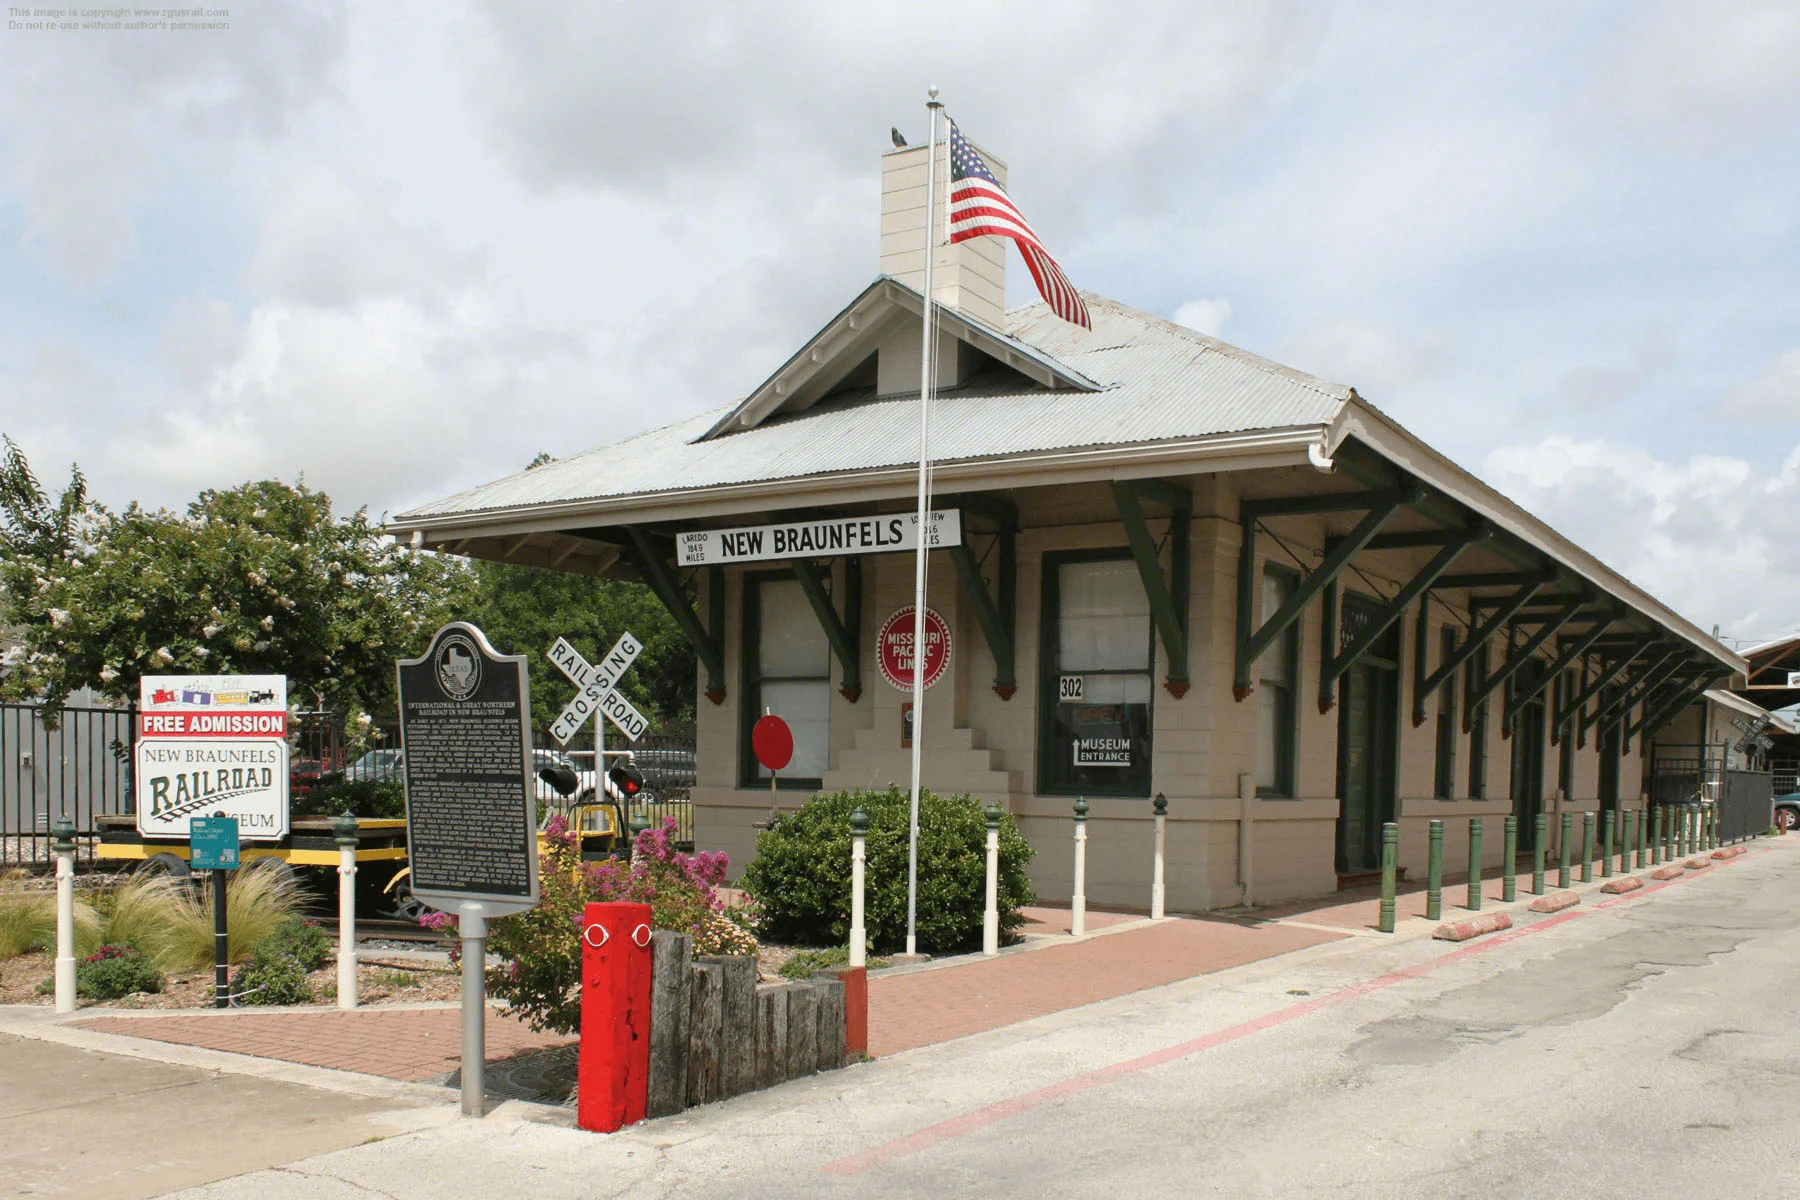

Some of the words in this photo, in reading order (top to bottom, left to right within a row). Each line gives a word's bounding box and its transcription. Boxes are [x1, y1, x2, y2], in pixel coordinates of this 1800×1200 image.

[681, 534, 708, 545] LAREDO
[721, 531, 764, 557] NEW
[774, 519, 903, 553] BRAUNFELS
[686, 553, 705, 562] MILES
[898, 658, 929, 670] LINS
[552, 643, 588, 686] RAIL
[603, 693, 644, 736] ROAD
[554, 640, 635, 739] CROSSING
[1061, 678, 1082, 697] 302
[143, 716, 185, 733] FREE
[189, 716, 284, 733] ADMISSION
[1081, 739, 1130, 750] MUSEUM
[145, 749, 181, 762] NEW
[186, 749, 276, 763] BRAUNFELS
[1081, 752, 1130, 761] ENTRANCE
[150, 767, 273, 816] RAILROAD
